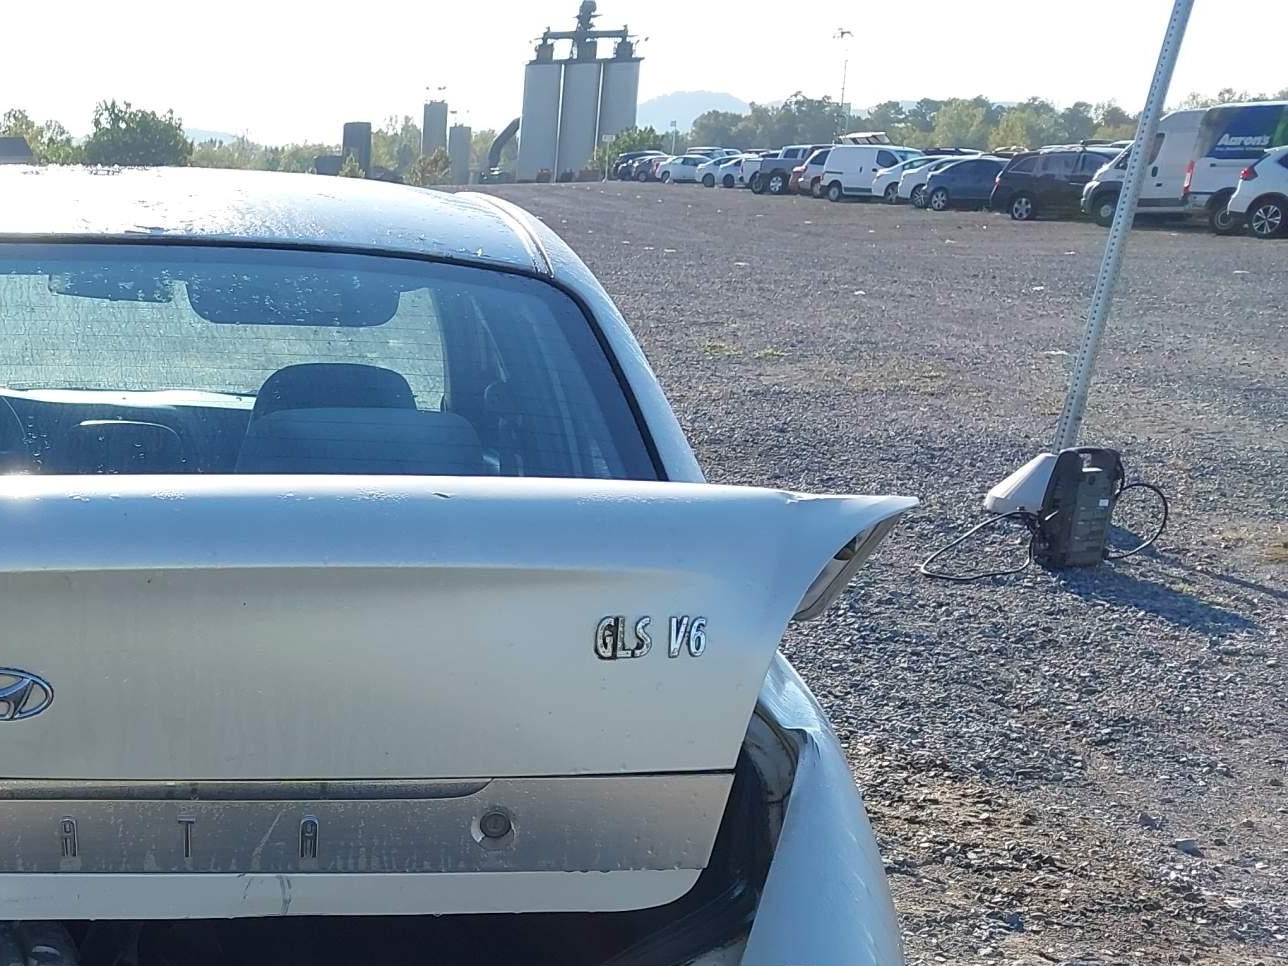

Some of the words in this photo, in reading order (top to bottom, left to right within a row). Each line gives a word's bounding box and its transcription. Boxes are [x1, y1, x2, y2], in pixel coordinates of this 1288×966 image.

[1217, 134, 1270, 146] Aaron's
[594, 615, 652, 660] GLS
[668, 615, 707, 658] V6
